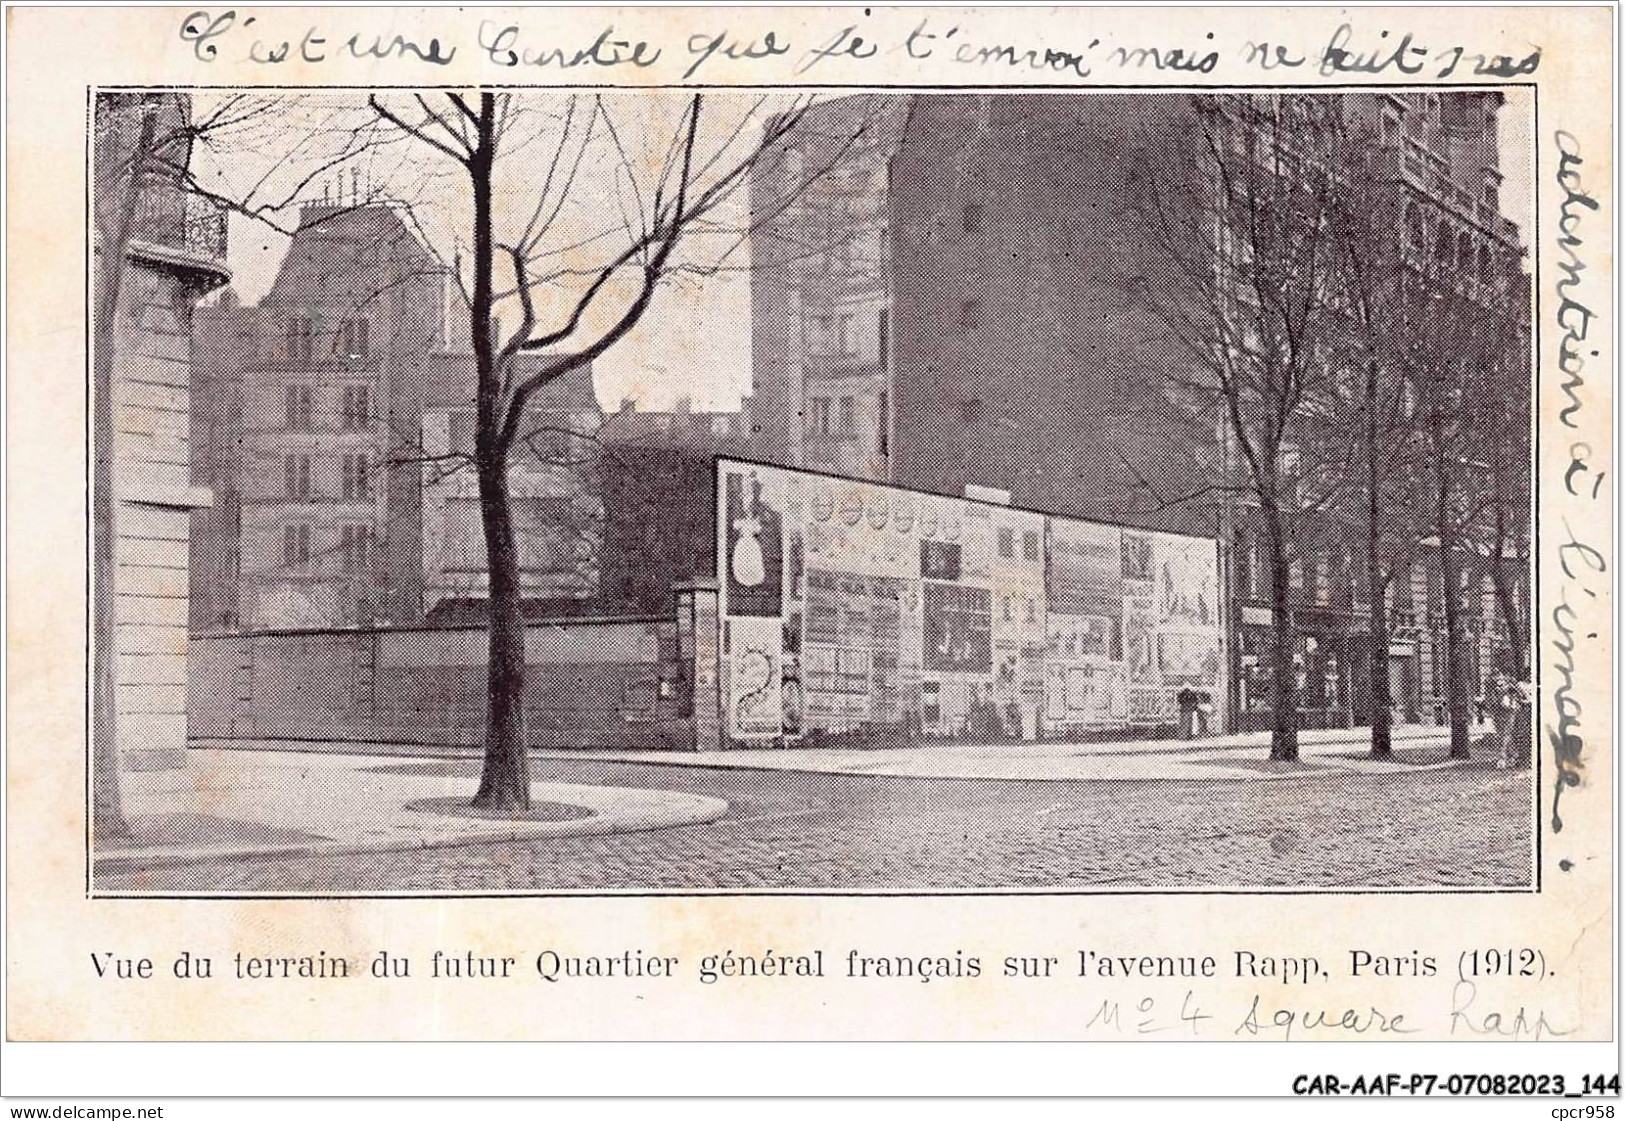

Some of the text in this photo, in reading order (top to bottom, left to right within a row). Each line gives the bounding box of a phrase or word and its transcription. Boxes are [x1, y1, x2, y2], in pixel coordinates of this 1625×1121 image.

[340, 33, 457, 66] une
[682, 30, 791, 79] que
[1107, 31, 1219, 73] mais
[1238, 42, 1306, 70] ne
[91, 948, 1556, 985] Vue du terrain du futur Quartier général français sur l'avenue Rapp, Paris (1912).
